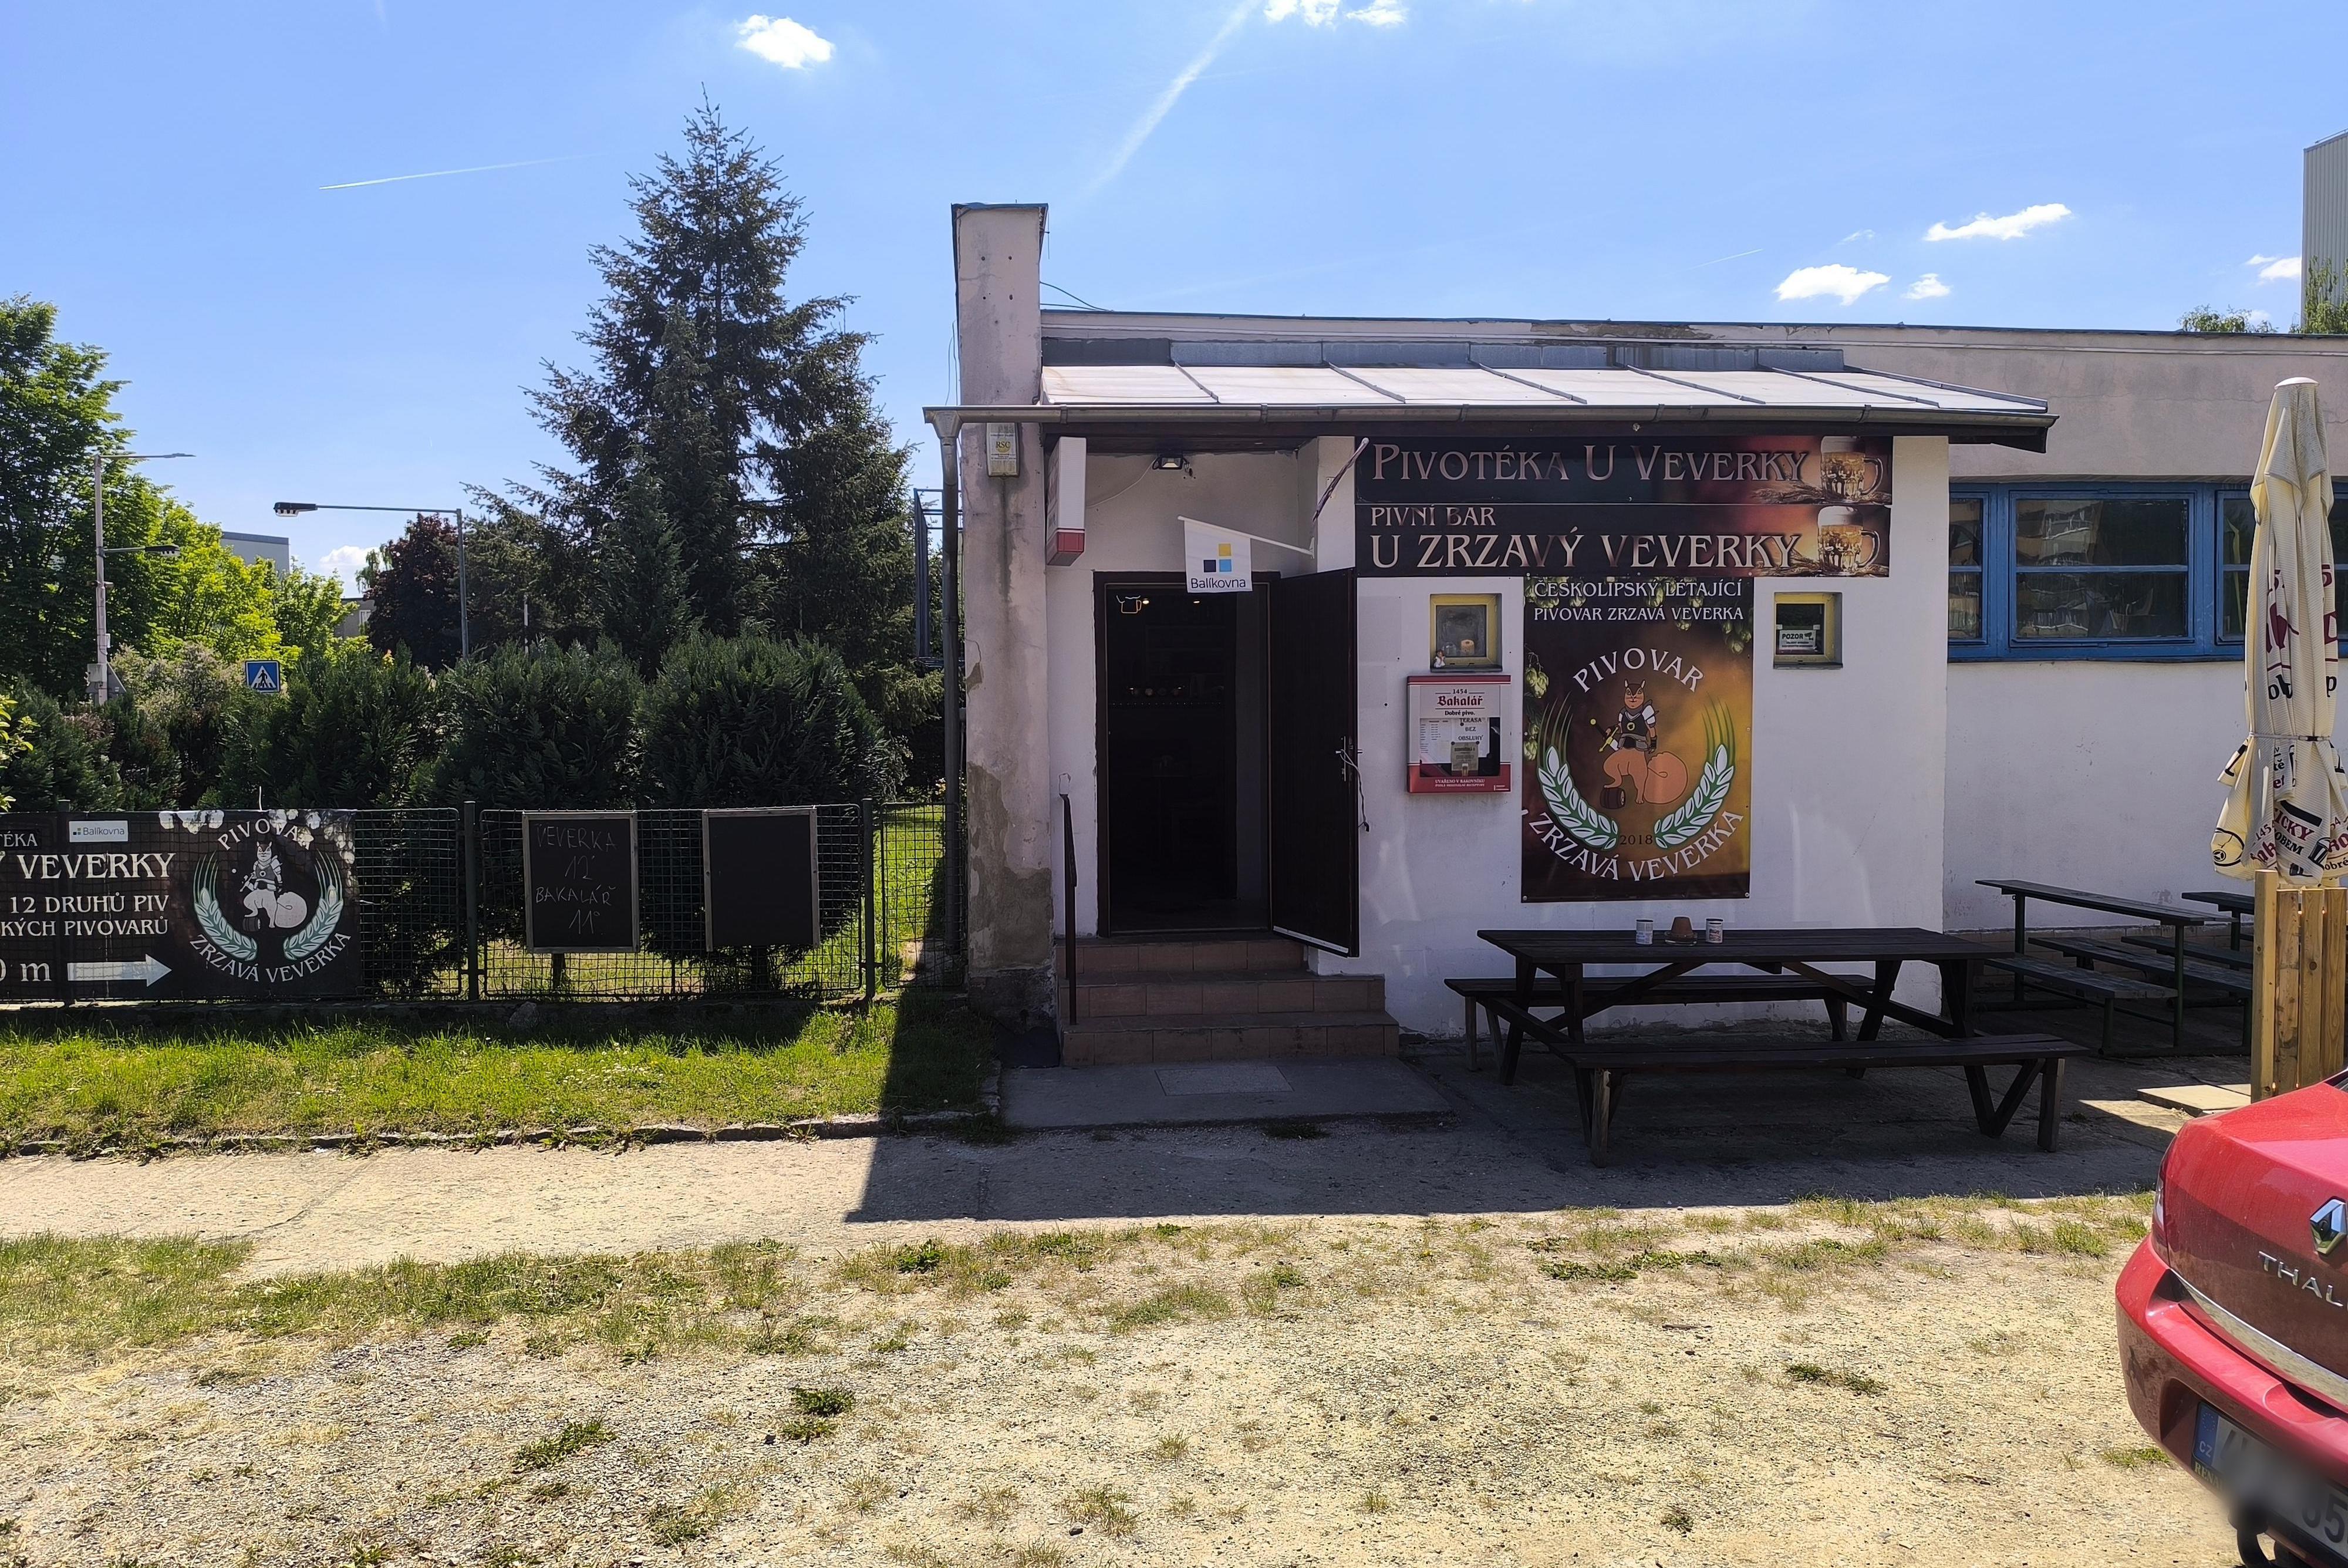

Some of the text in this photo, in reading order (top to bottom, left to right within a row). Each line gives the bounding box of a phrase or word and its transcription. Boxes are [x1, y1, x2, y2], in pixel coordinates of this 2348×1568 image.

[1372, 444, 1809, 481] PIVOTÉKA U VEVERKY
[1370, 504, 1496, 526] PIVNÍ BAR
[1369, 526, 1802, 568] U ZRZAVÝ VEVERKY
[1190, 578, 1246, 588] Balíkovna
[1534, 578, 1742, 597] ČESKOLIPSKÝ LÉTAJÍCÍ
[1534, 605, 1744, 621] PIVOVAR ZRZAVÁ VEVERKA
[1573, 648, 1705, 693] PIVOVAR
[1437, 696, 1483, 706] Bakalář
[83, 827, 125, 835] Balíkovna
[537, 825, 616, 851] VEVERKA
[1620, 835, 1653, 845] 2018
[1529, 810, 1744, 881] ZRZAVÁ VEVERKA
[16, 852, 176, 879] VEVERKY
[10, 892, 170, 913] 12 DRUHŮ PIV
[535, 884, 616, 906] BAKALÁŘ
[64, 916, 168, 936] PIVOVARŮ
[190, 932, 352, 983] ZRZAVÁ VEVERKA
[20, 962, 52, 982] m
[2258, 1250, 2348, 1310] THAL
[2199, 1440, 2213, 1458] CZ
